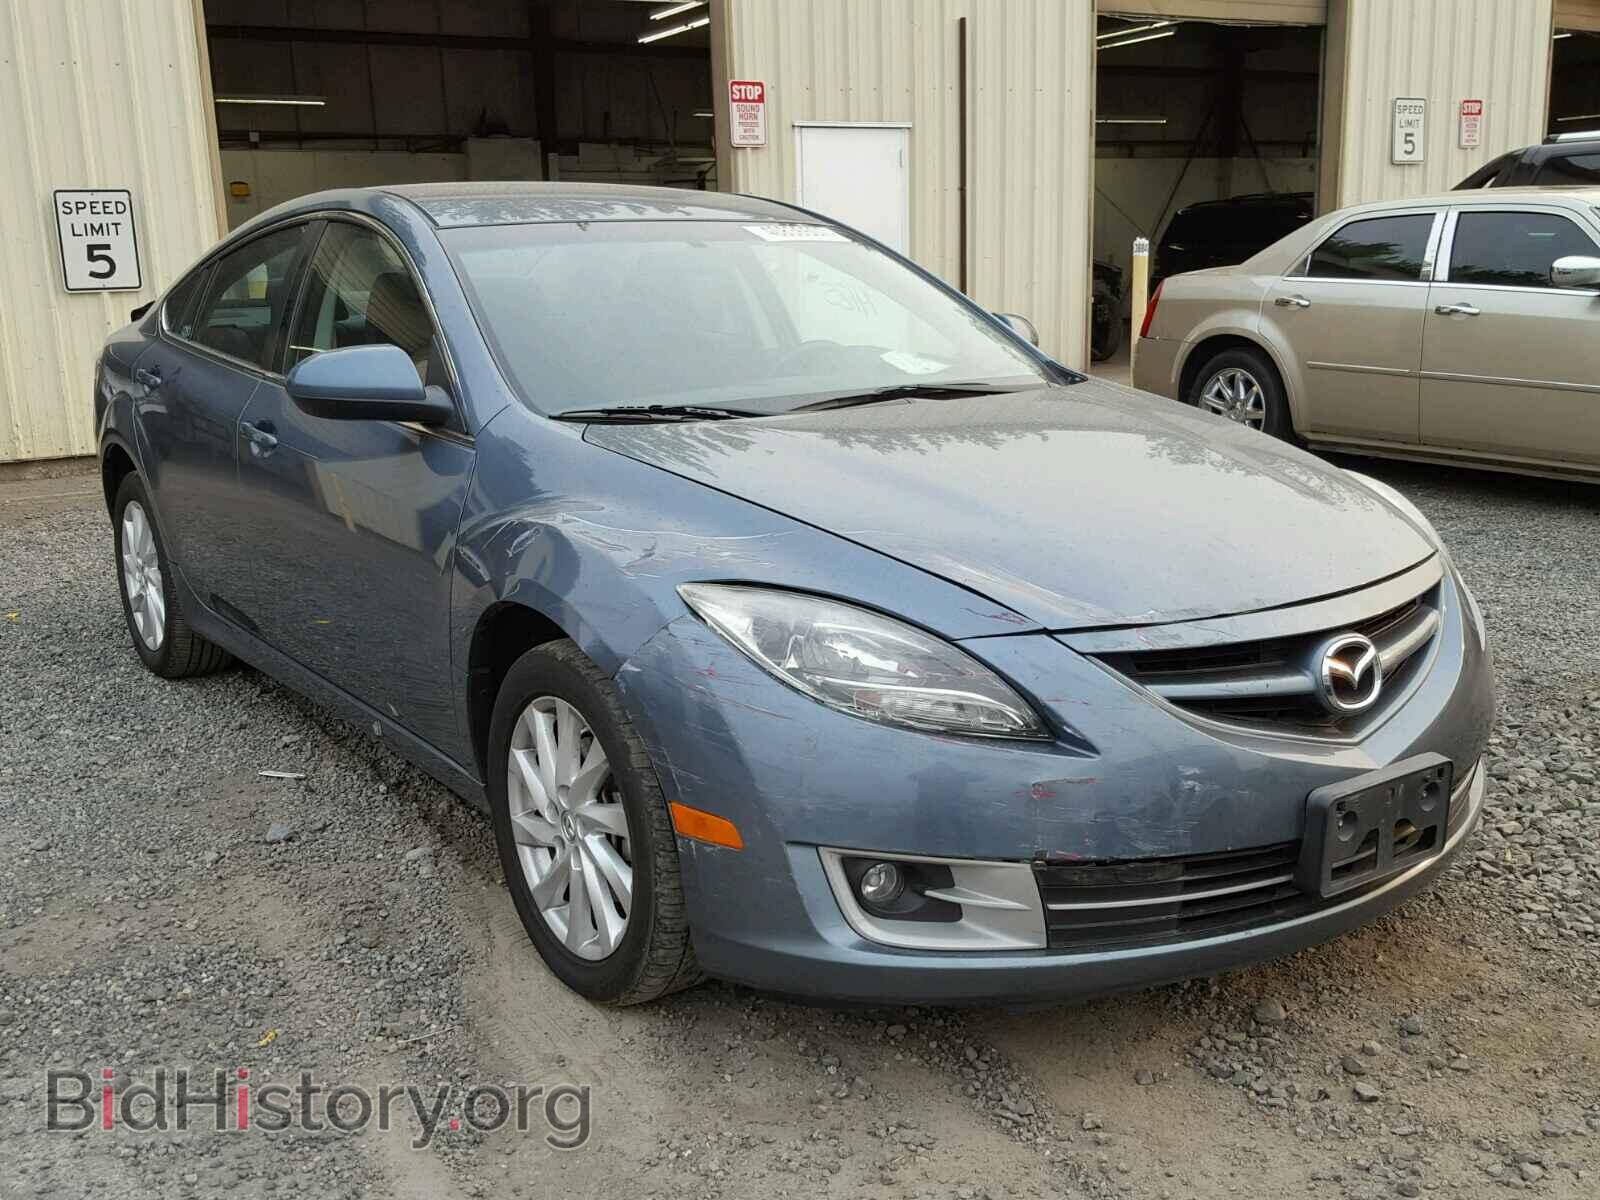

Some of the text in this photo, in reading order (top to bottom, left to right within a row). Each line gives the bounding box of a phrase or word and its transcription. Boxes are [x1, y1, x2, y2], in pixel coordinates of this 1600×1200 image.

[732, 84, 762, 100] STOP
[736, 104, 760, 113] SOUND
[1396, 104, 1424, 115] SPEED
[1463, 102, 1481, 113] STOP
[739, 112, 758, 120] HORN
[1399, 119, 1421, 129] LIMIT
[1403, 132, 1416, 155] 5
[61, 200, 127, 215] SPEED
[70, 222, 122, 237] LIMIT
[86, 243, 117, 279] 5
